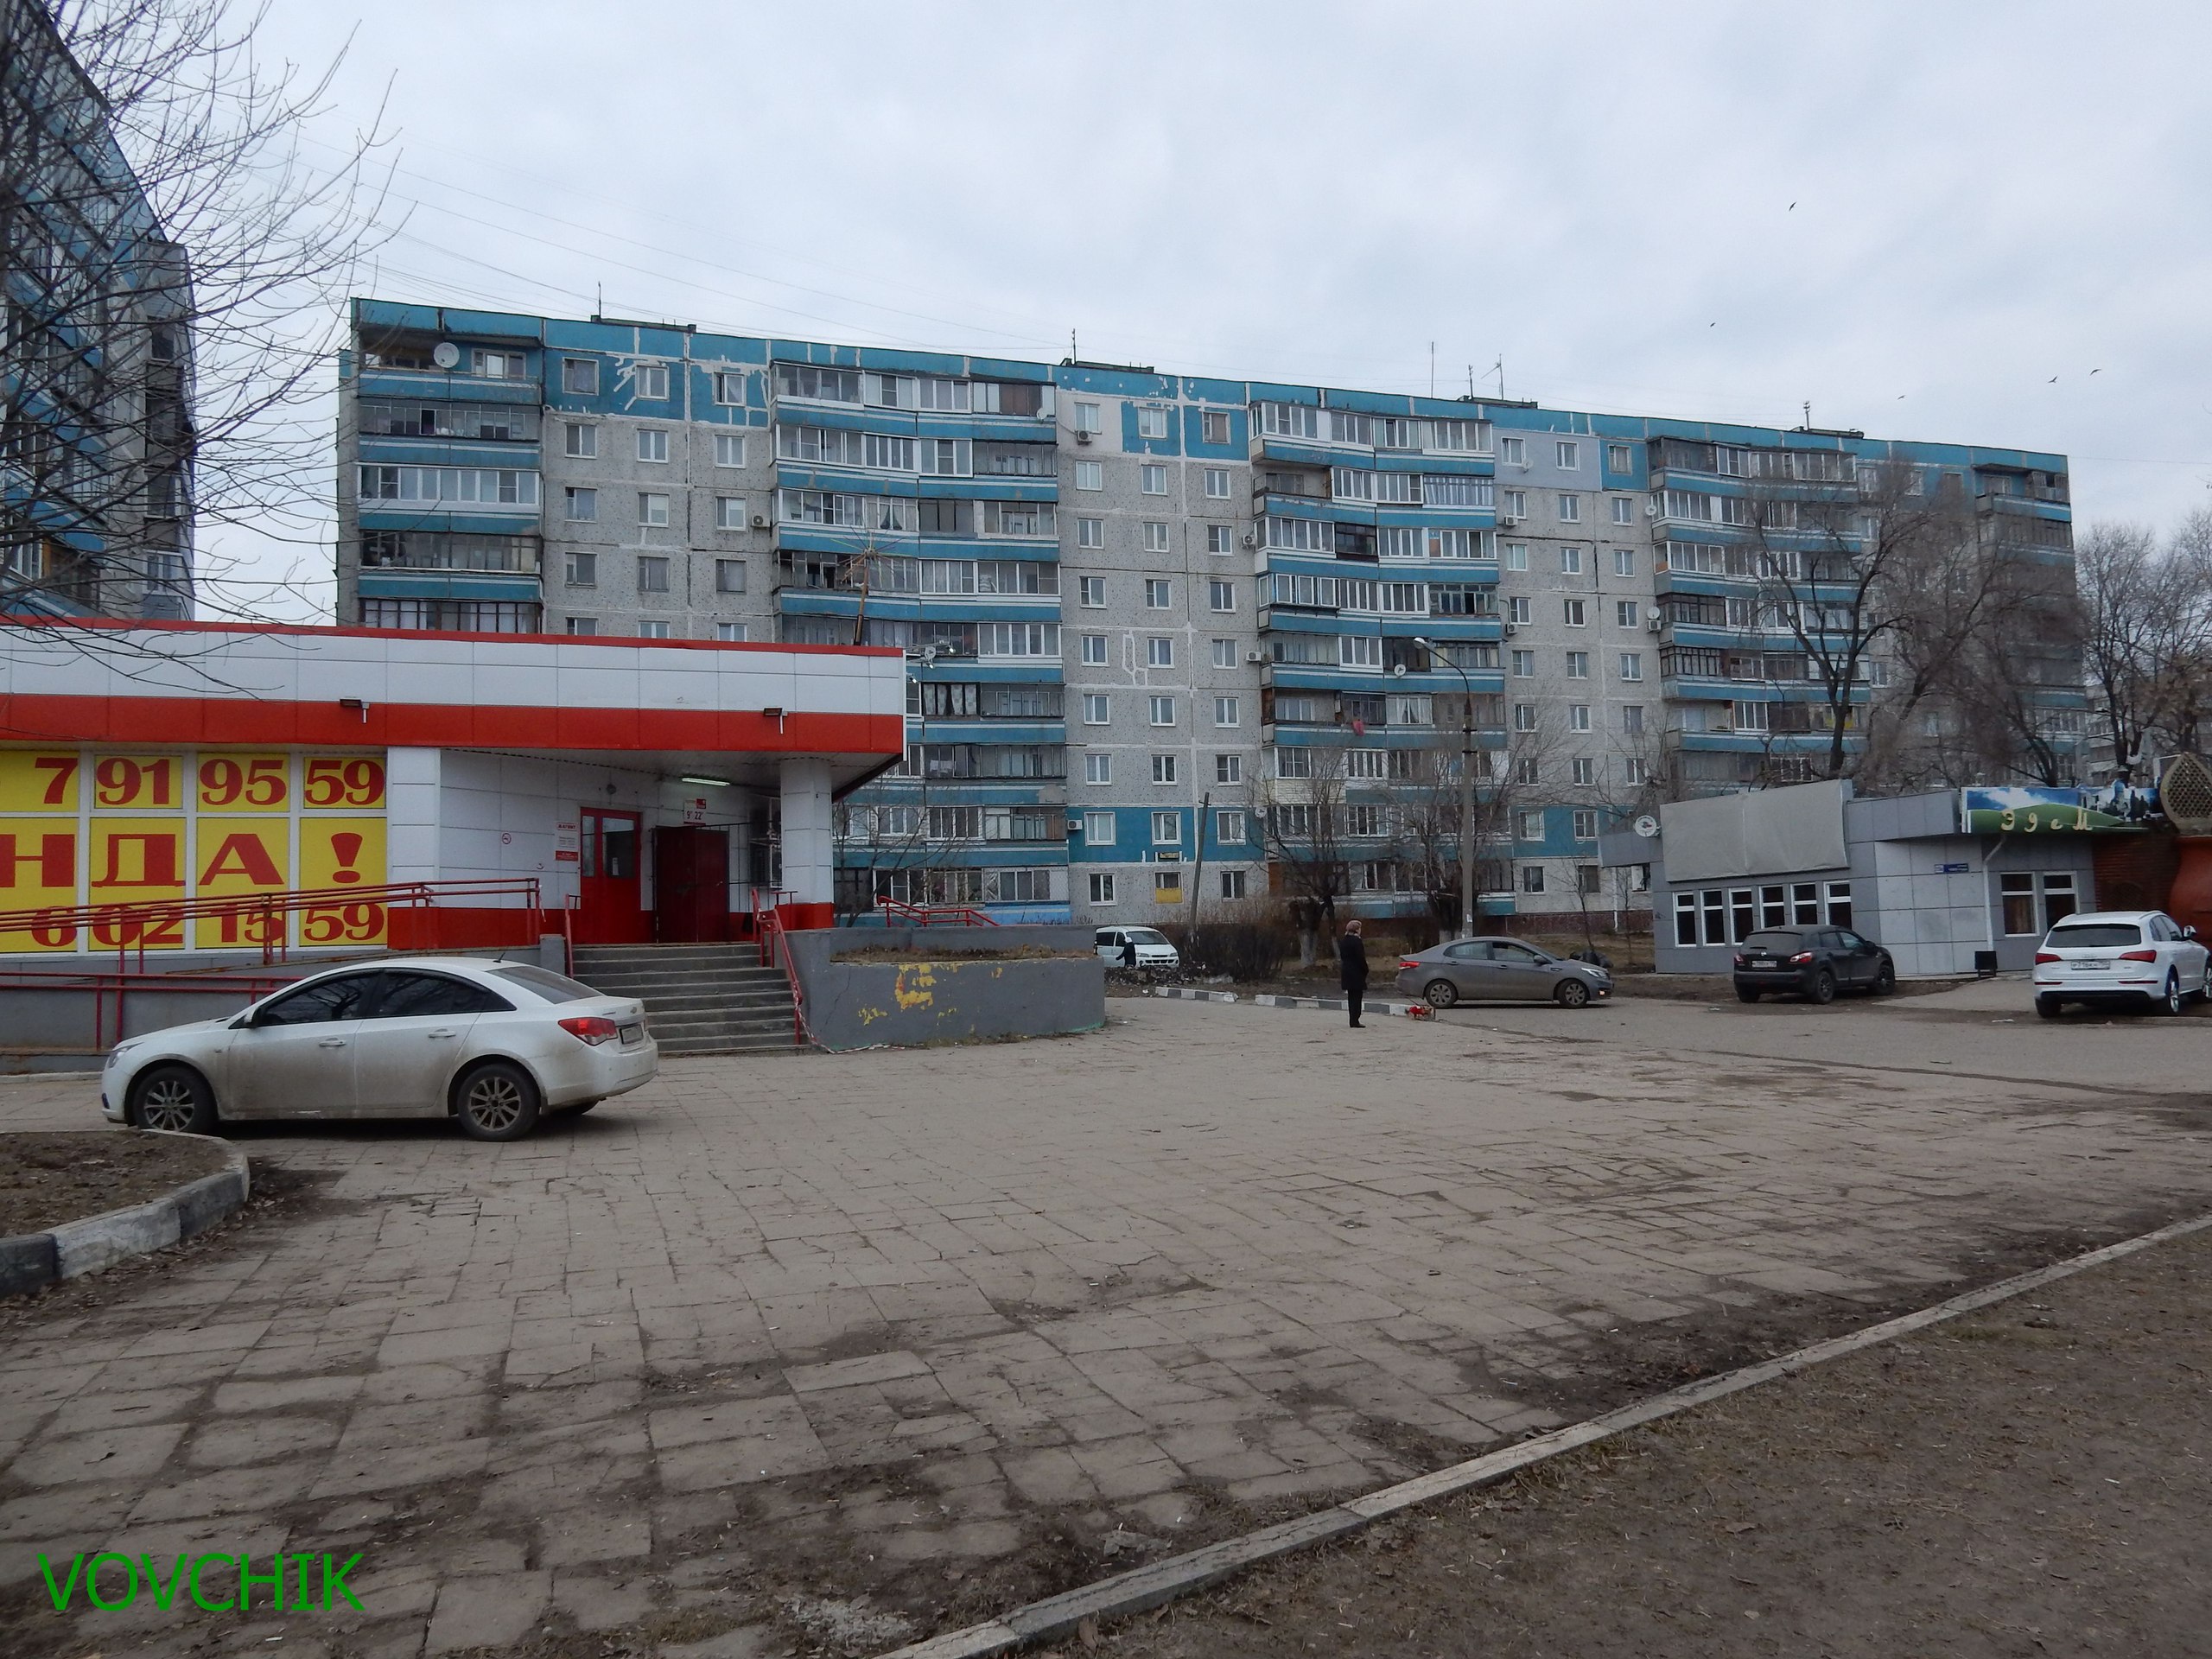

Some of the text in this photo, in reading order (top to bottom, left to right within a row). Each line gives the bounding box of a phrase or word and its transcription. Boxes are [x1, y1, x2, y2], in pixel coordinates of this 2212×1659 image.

[200, 759, 287, 805] 95
[304, 760, 385, 805] 59
[304, 903, 385, 942] 59
